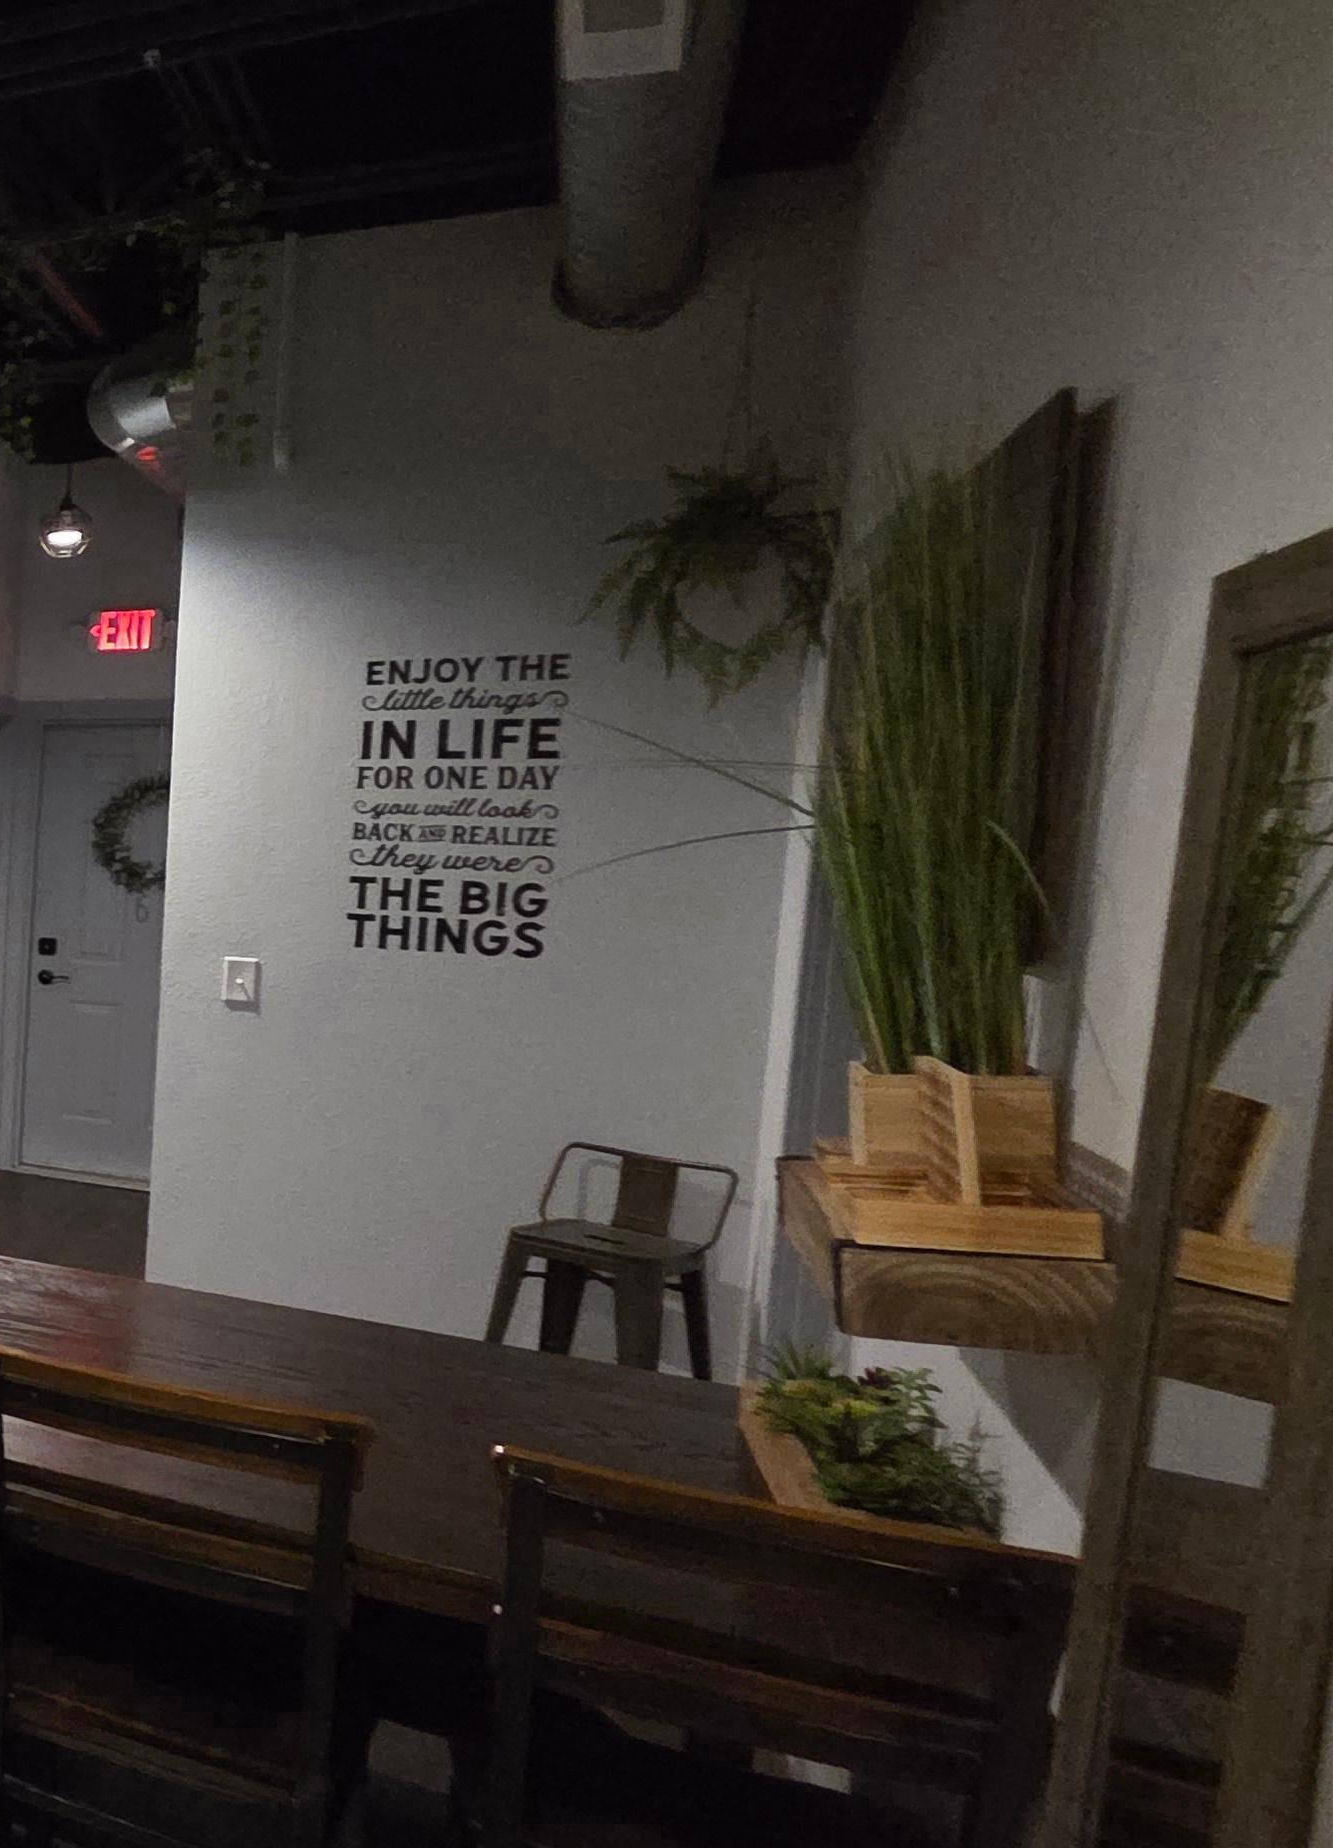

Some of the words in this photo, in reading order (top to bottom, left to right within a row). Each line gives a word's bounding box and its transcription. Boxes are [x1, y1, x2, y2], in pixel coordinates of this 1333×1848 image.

[98, 610, 155, 650] EXIT
[366, 656, 483, 685] ENJOY
[496, 653, 570, 681] THE
[362, 688, 445, 712] little
[448, 687, 569, 714] things
[360, 720, 416, 759] IN
[437, 718, 561, 759] LIFE
[356, 766, 413, 790] FOR
[424, 765, 488, 790] ONE
[497, 765, 560, 790] DAY
[354, 800, 420, 819] you
[422, 797, 477, 818] will
[477, 799, 559, 820] look
[352, 822, 415, 842] BACK
[419, 827, 446, 840] AND
[451, 827, 557, 847] REALIZE
[349, 844, 438, 875] they
[441, 854, 554, 875] were
[349, 876, 444, 913] THE
[459, 880, 549, 918] BIG
[346, 913, 547, 959] THINGS
